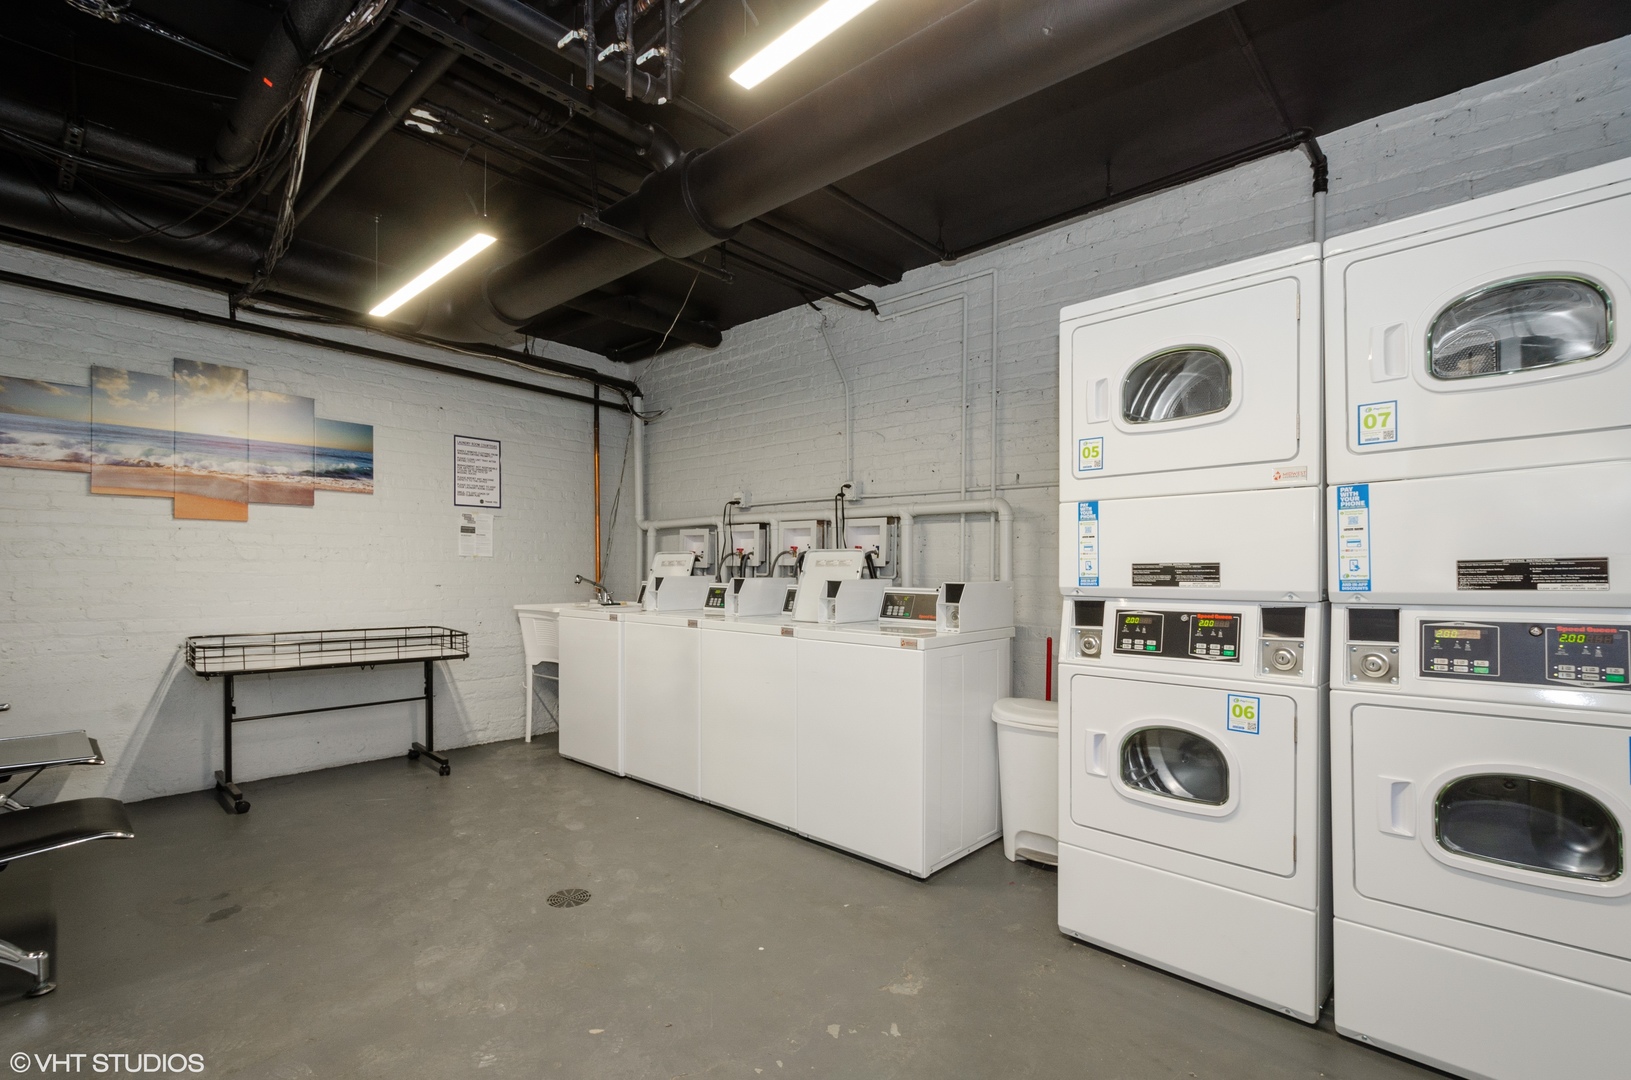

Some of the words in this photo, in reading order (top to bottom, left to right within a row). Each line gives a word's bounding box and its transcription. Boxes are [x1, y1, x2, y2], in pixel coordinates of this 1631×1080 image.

[1363, 412, 1391, 429] 07
[1082, 446, 1099, 459] 05
[1435, 630, 1458, 638] 2.00
[1559, 633, 1586, 643] 2.00
[1232, 704, 1255, 719] 06
